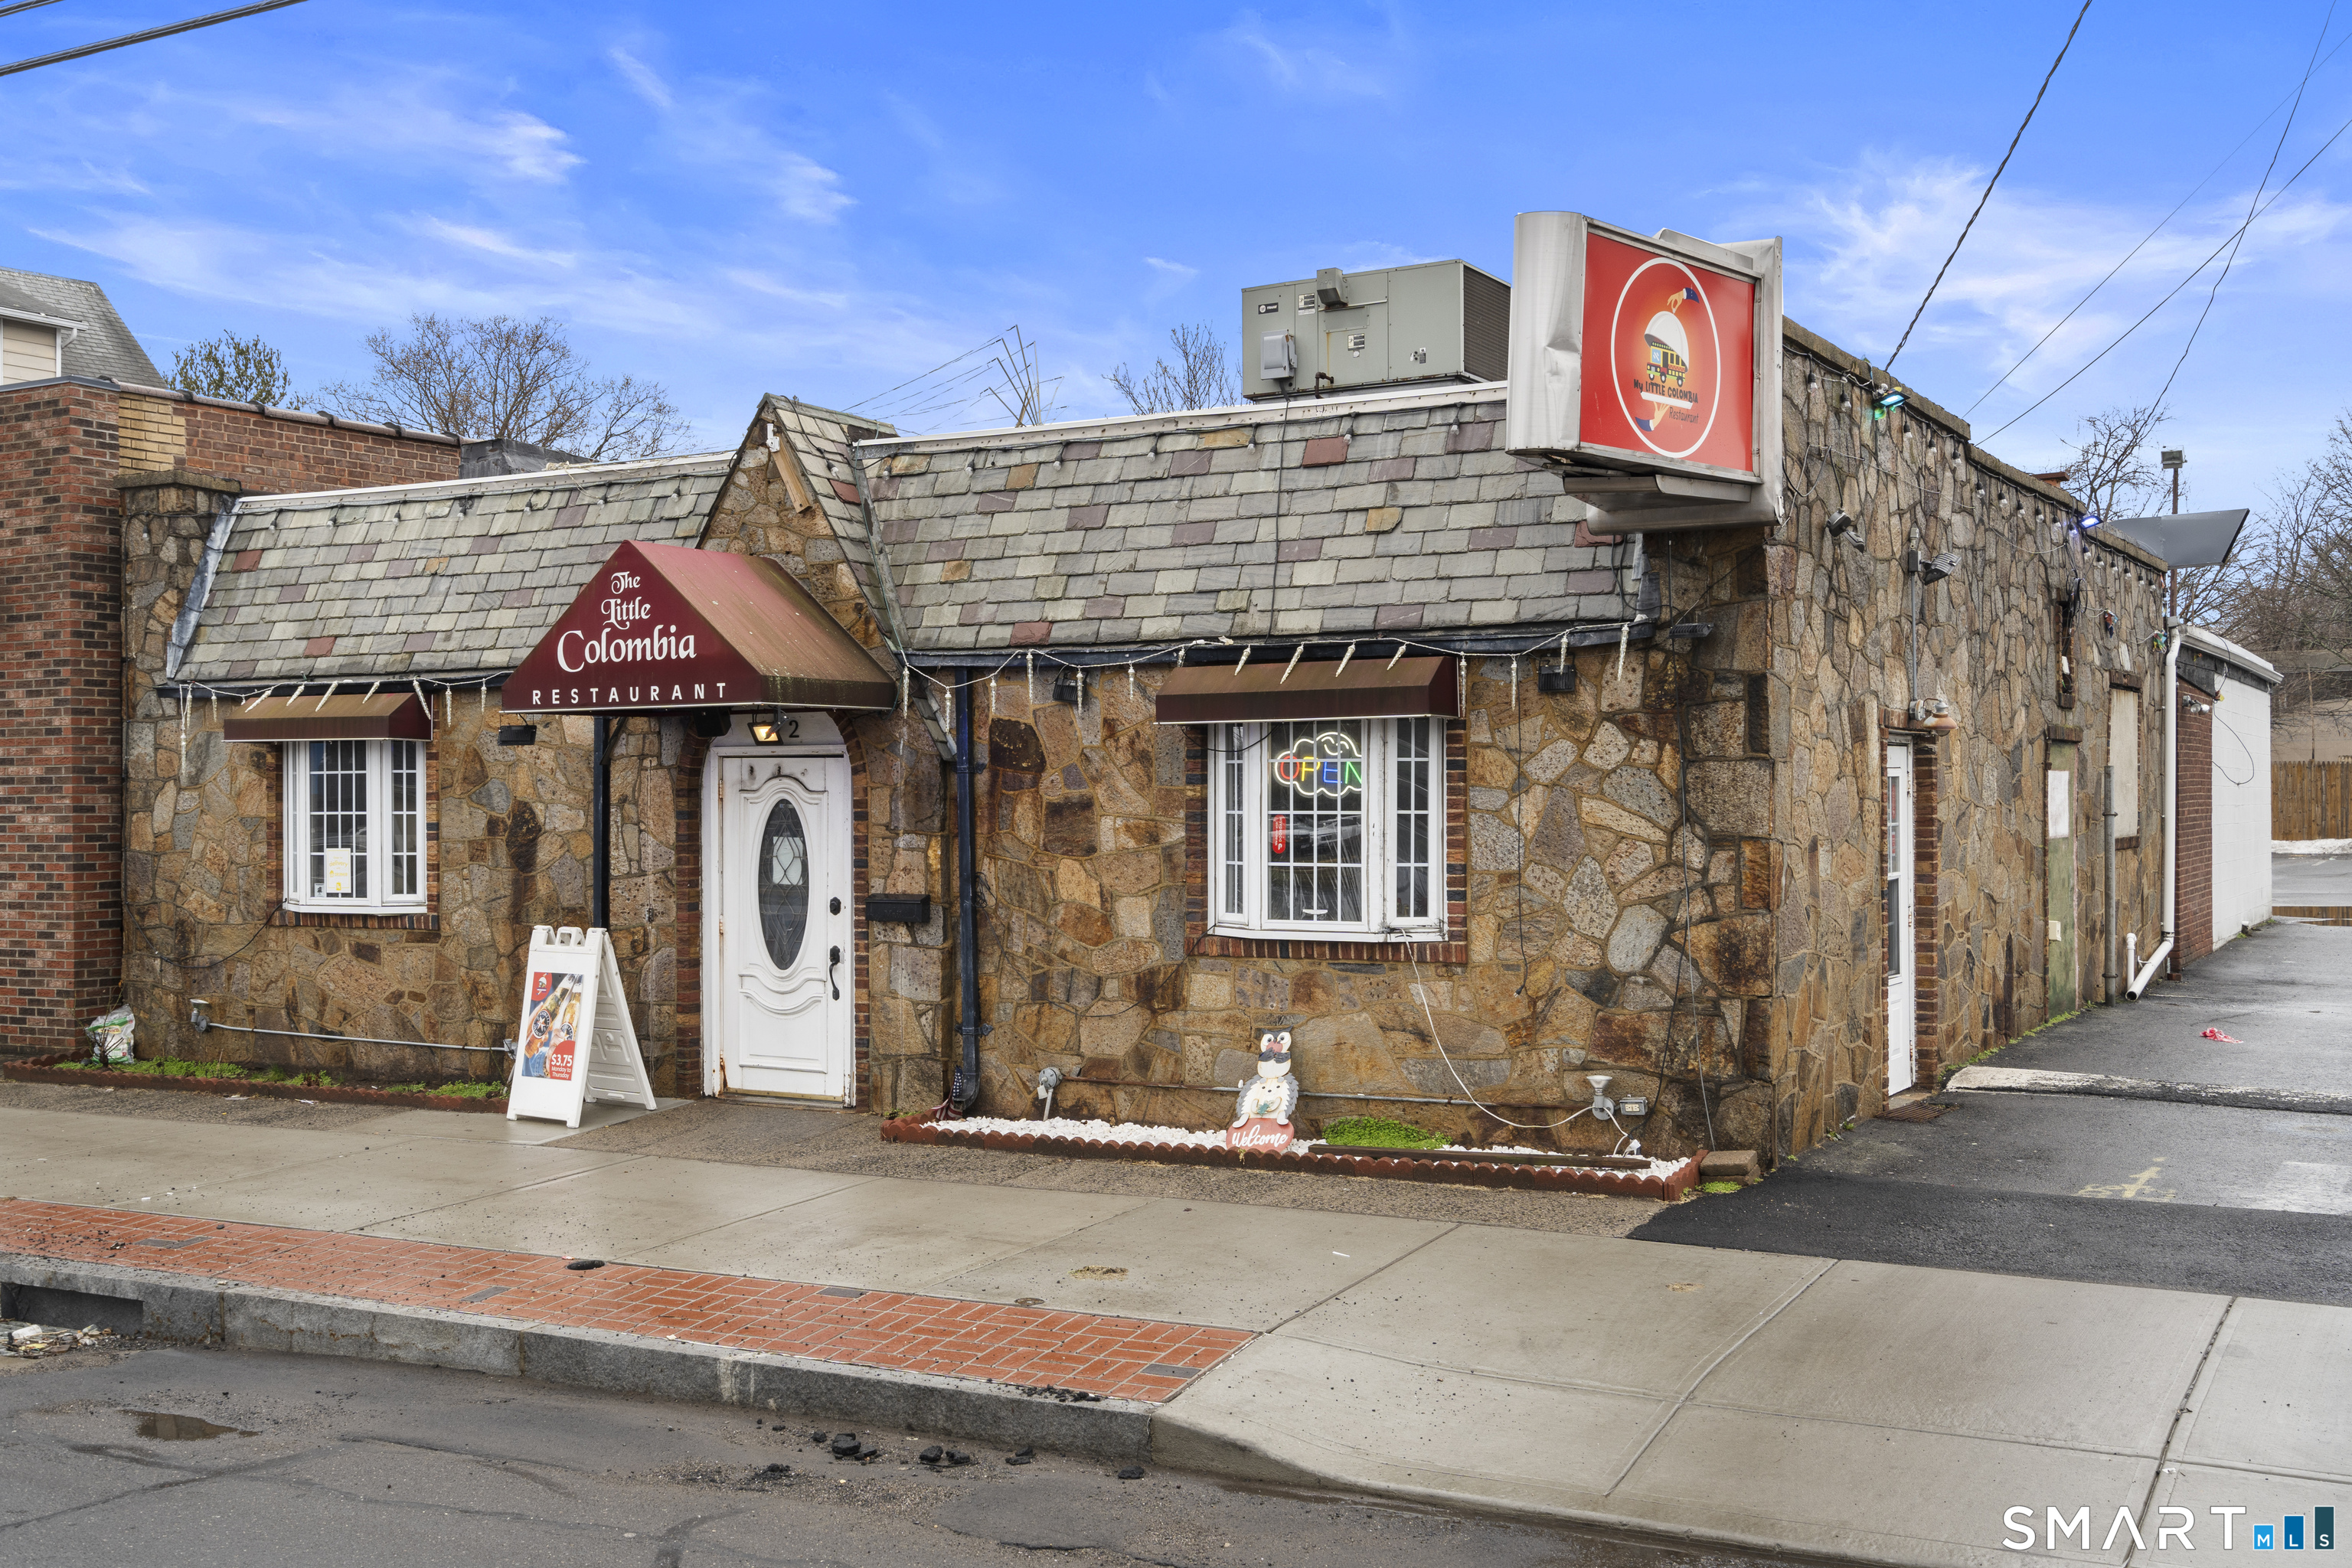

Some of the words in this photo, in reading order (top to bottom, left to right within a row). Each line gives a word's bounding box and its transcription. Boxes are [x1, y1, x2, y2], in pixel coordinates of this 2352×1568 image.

[1633, 378, 1644, 394] My
[1645, 381, 1666, 396] LITTLE
[1668, 387, 1699, 403] COLOMBIA
[1668, 407, 1700, 424] Restaurant
[611, 571, 641, 594] The
[601, 596, 651, 630] Little
[557, 624, 697, 673] Colombia
[532, 682, 726, 705] RESTAURANT
[789, 720, 799, 738] 2
[1280, 755, 1362, 784] OPEN
[551, 1054, 573, 1067] $3.75
[1231, 1124, 1289, 1148] Welcome
